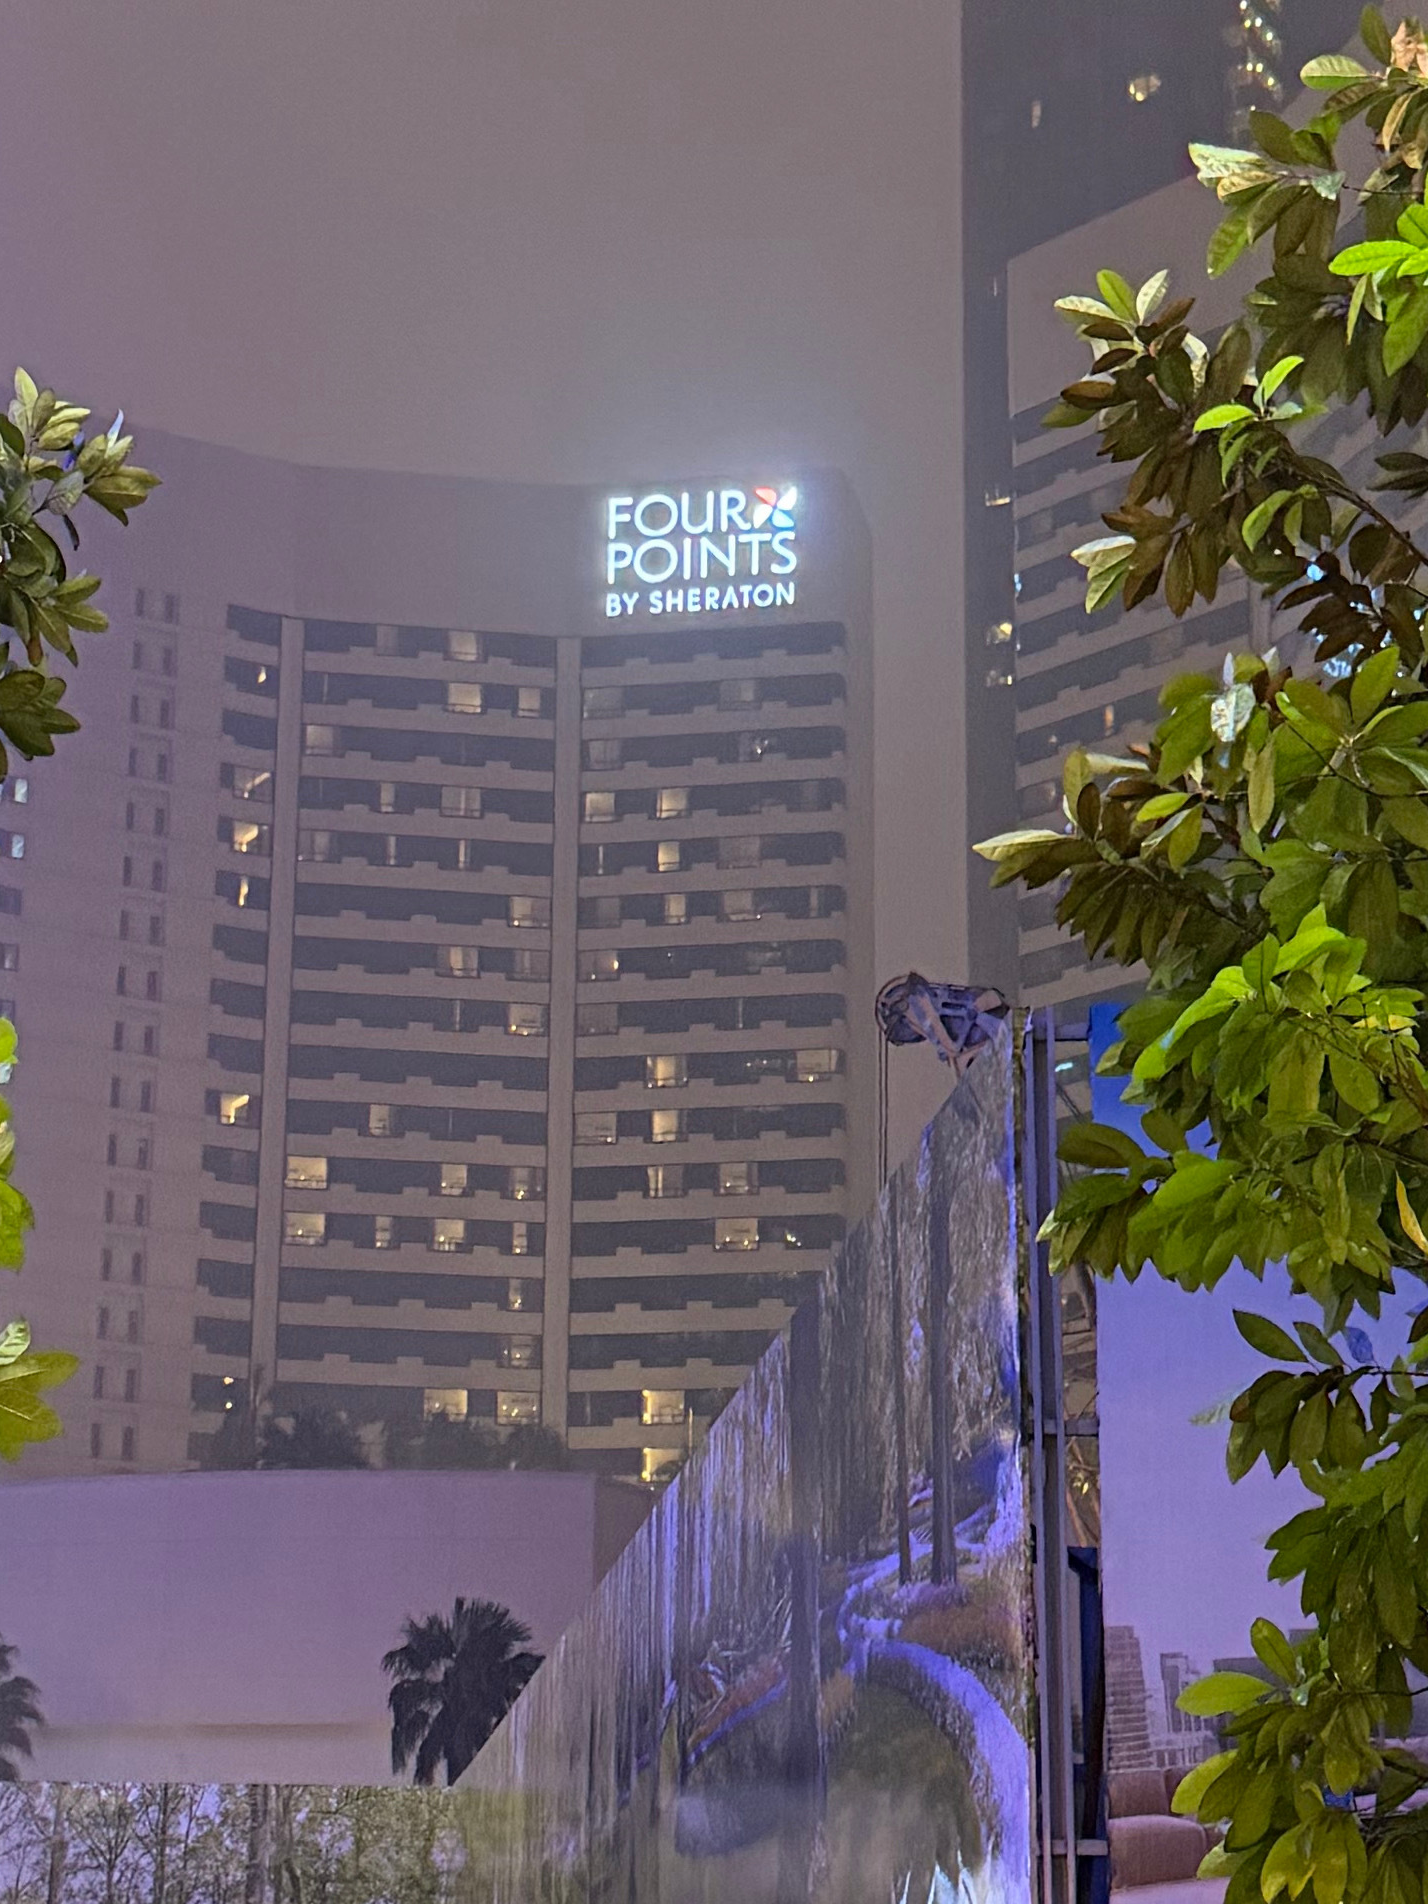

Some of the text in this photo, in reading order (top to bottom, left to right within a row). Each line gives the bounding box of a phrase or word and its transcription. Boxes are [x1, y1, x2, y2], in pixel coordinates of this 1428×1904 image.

[608, 489, 752, 539] FOUR
[607, 531, 797, 584] POINTS
[605, 581, 795, 617] BY SHERATON
